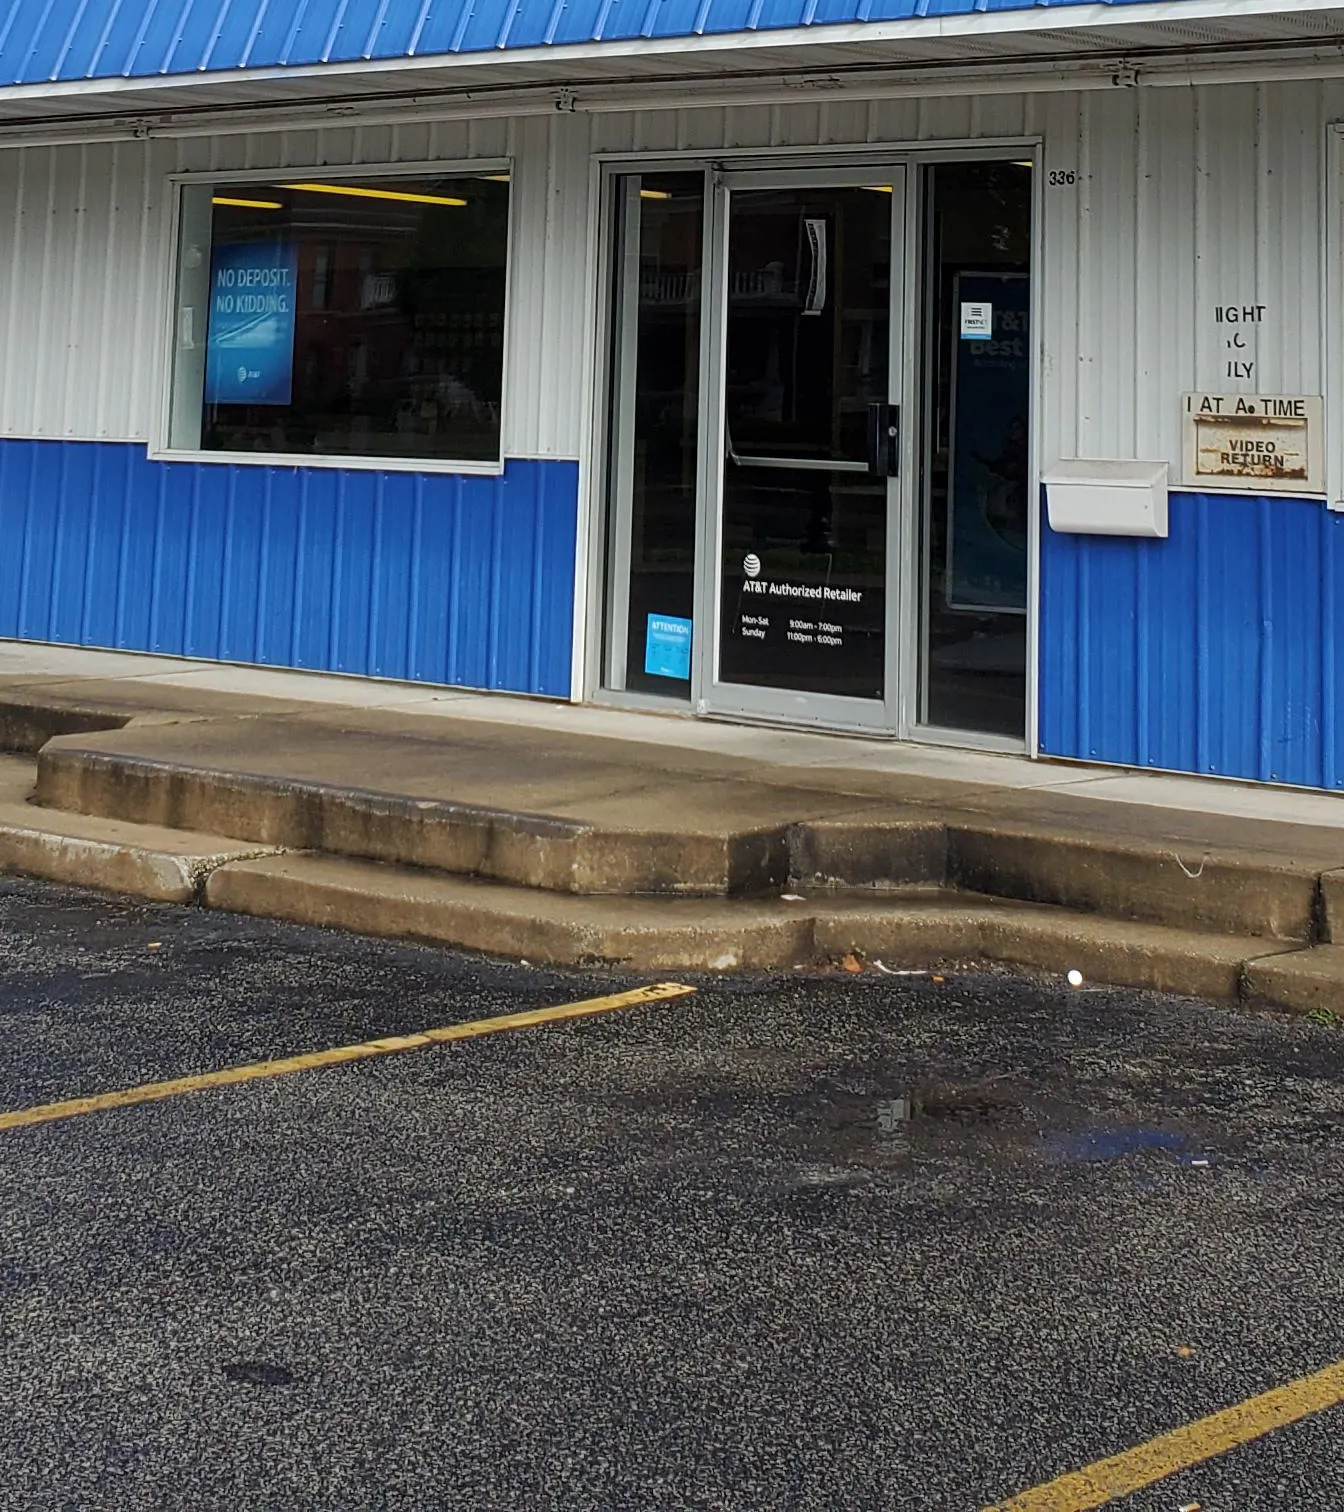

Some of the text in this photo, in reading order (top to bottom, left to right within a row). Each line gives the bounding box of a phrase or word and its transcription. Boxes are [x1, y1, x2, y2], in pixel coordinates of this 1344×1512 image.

[1049, 171, 1075, 185] 336
[217, 269, 291, 287] NO DEPOSIT.
[216, 294, 289, 313] NO KIDDING.
[1200, 396, 1224, 414] AT
[1260, 399, 1305, 416] TIME
[1229, 440, 1276, 453] VIDEO
[1220, 452, 1284, 467] RETURN
[743, 580, 862, 602] AT&T Authorized Retailer
[742, 626, 766, 639] Sunday
